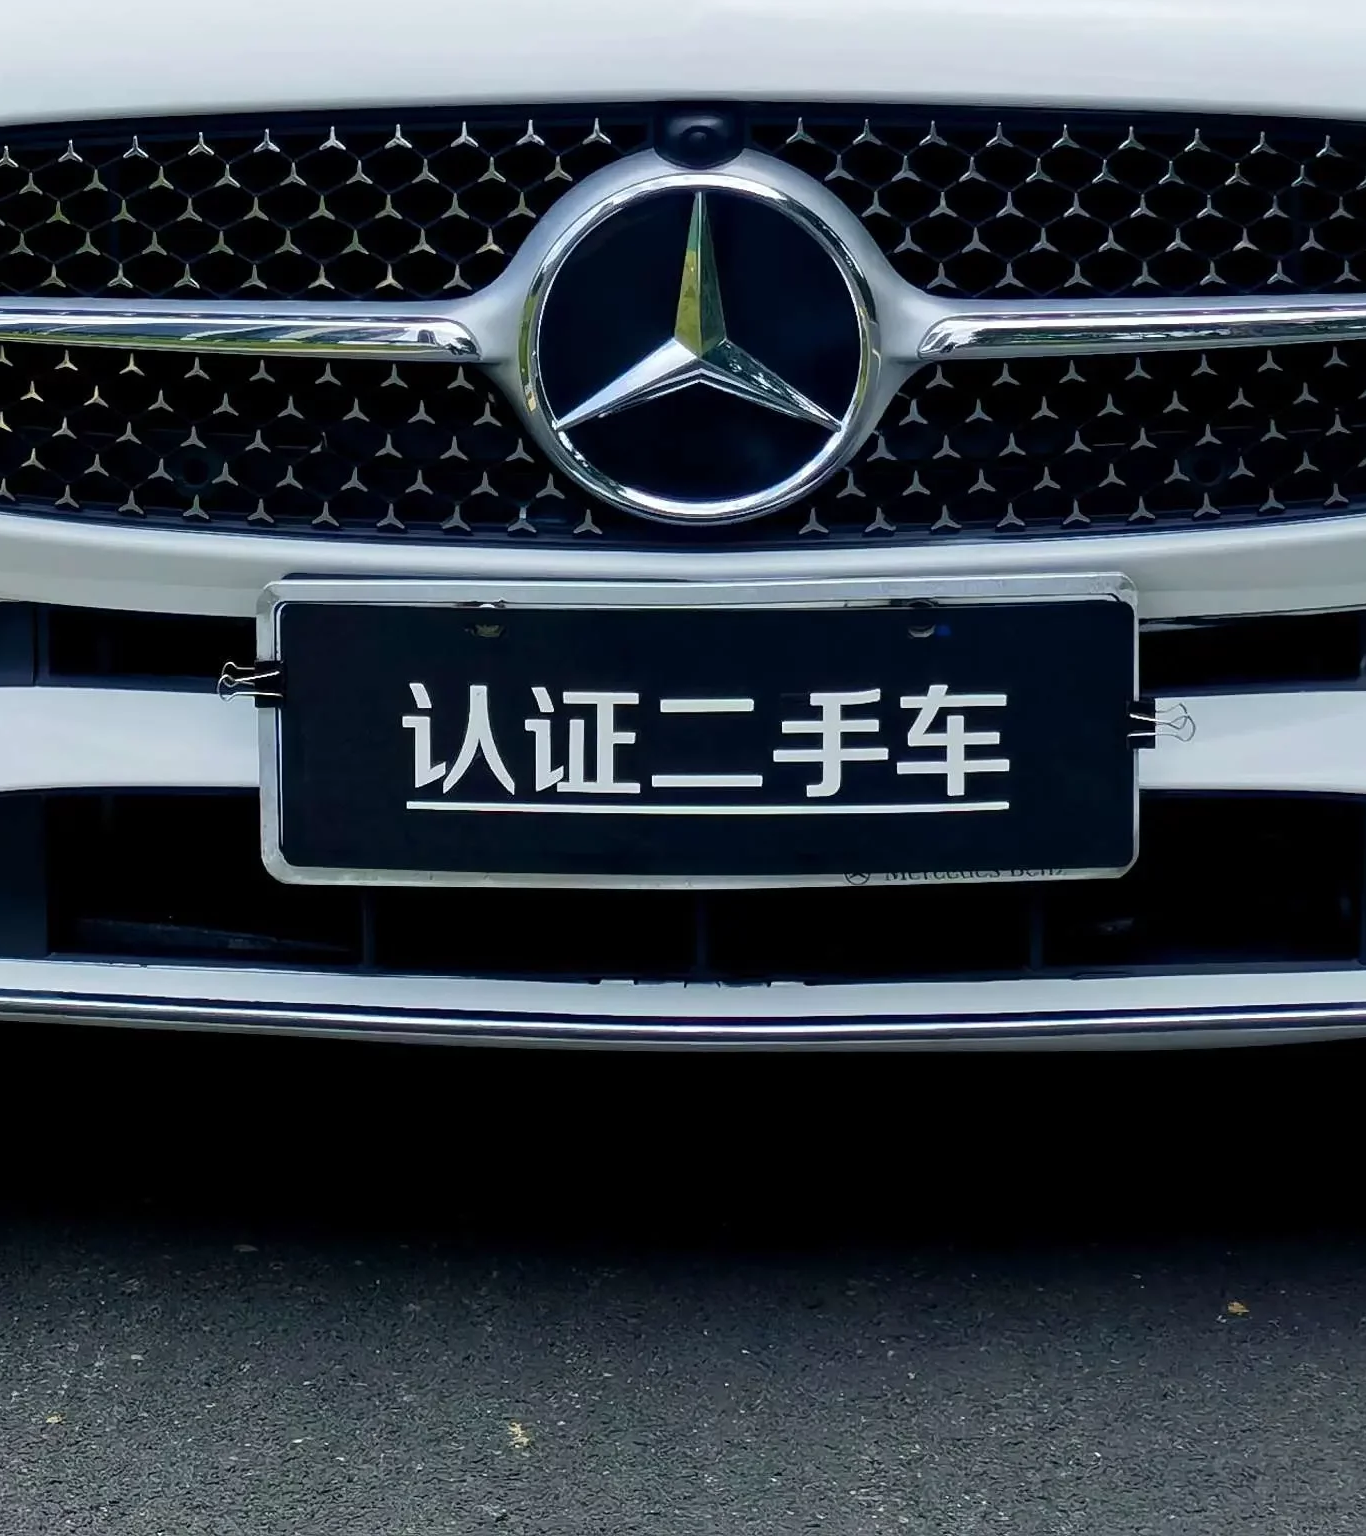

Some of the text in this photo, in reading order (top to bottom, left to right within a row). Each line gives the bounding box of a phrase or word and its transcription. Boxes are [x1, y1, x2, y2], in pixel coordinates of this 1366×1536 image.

[402, 681, 1011, 798] 认证二手车
